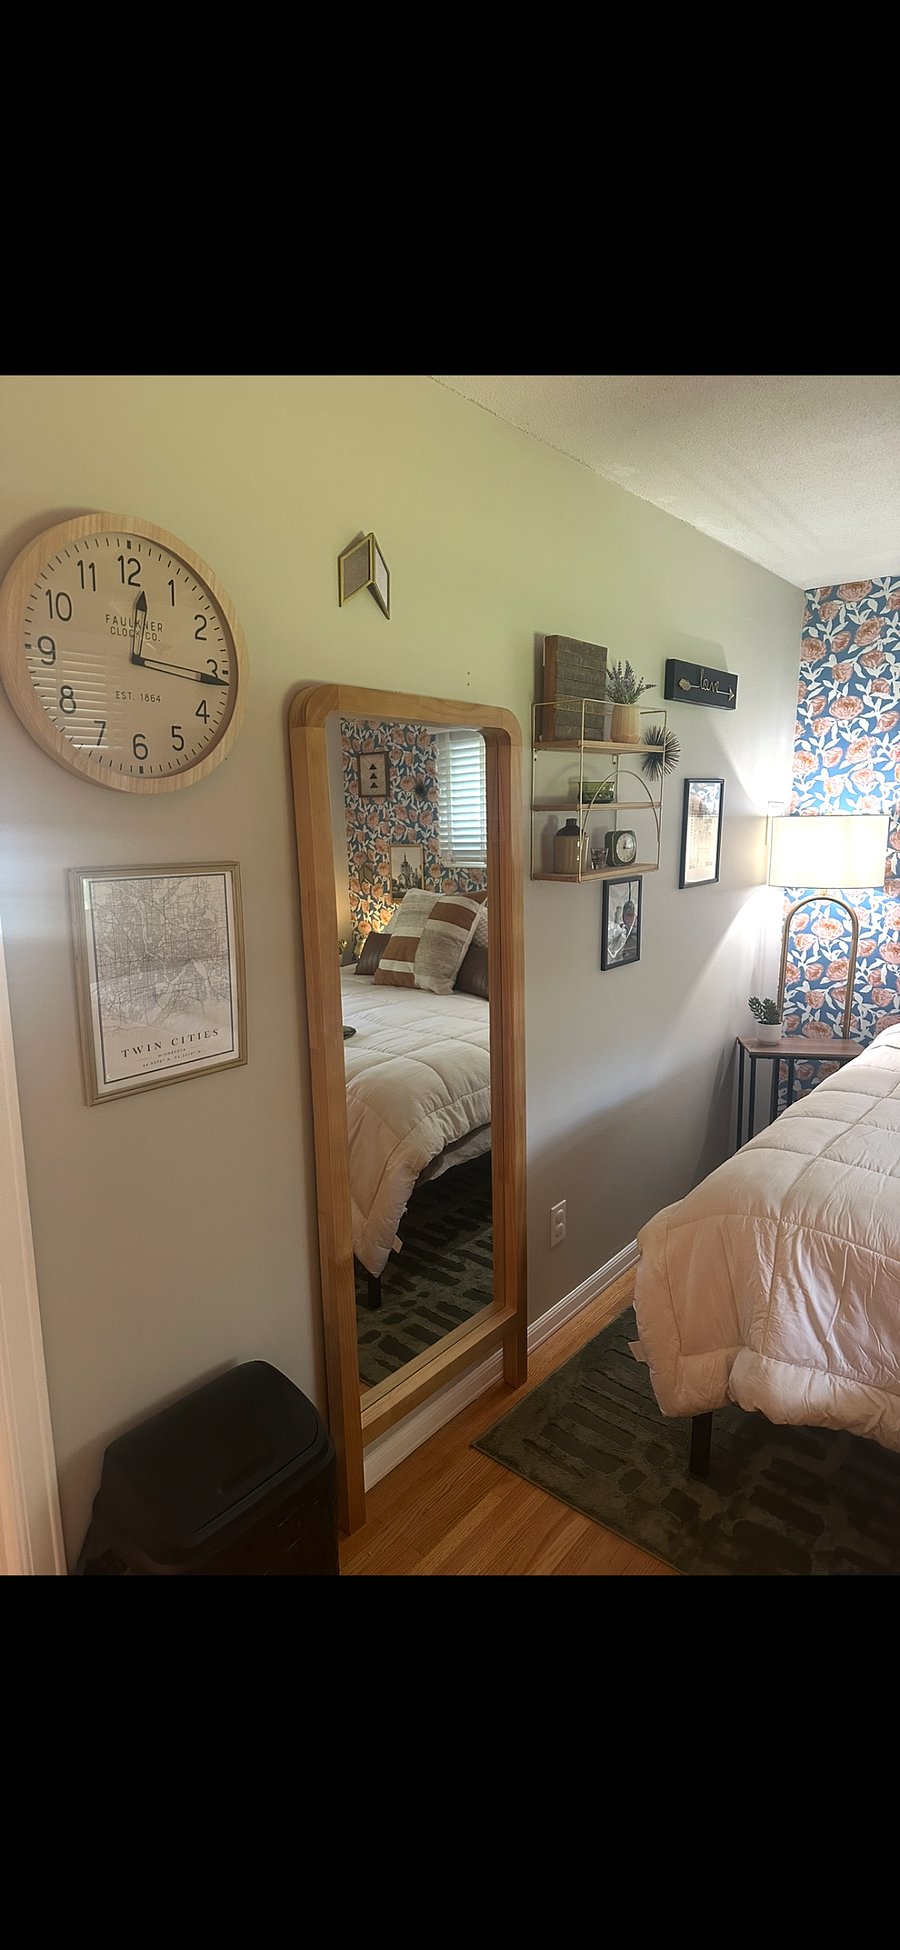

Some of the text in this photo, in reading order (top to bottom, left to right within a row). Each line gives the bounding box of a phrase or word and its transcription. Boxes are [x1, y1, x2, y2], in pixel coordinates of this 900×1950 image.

[77, 559, 97, 592] 11
[117, 555, 142, 588] 12
[45, 589, 72, 622] 10
[168, 579, 176, 607] 1
[105, 614, 163, 632] FAULKNER
[110, 626, 161, 642] CLOCK CO.
[194, 615, 208, 641] 2
[37, 636, 56, 665] 9
[206, 659, 219, 679] 3
[700, 668, 720, 693] love
[59, 685, 77, 714] 8
[115, 690, 161, 703] EST. 1864
[195, 700, 210, 724] 4
[93, 720, 107, 746] 7
[171, 726, 185, 751] 5
[133, 733, 149, 760] 6
[121, 1041, 162, 1058] TWIN
[171, 1028, 218, 1046] CITIES
